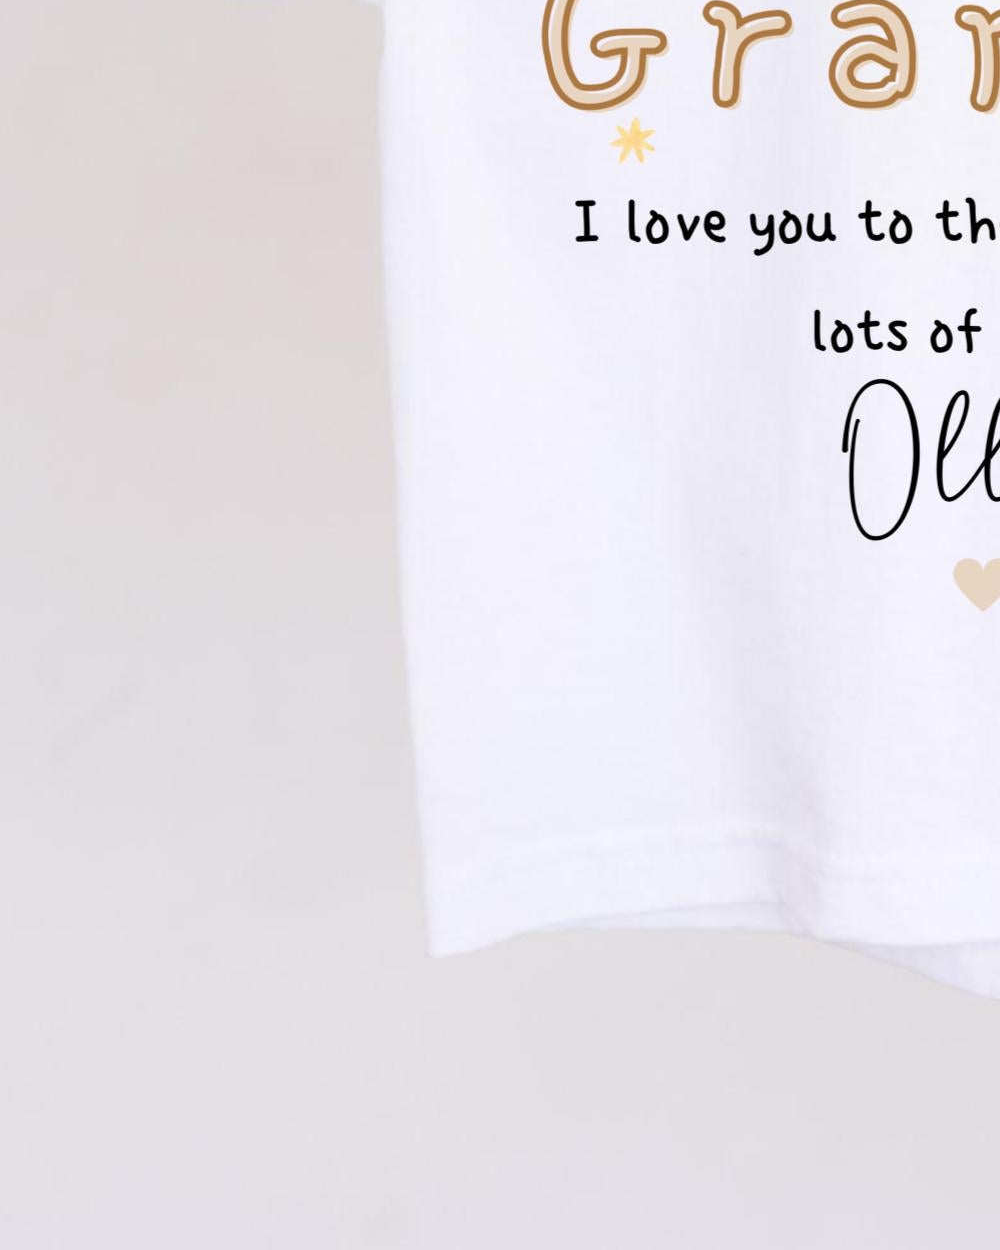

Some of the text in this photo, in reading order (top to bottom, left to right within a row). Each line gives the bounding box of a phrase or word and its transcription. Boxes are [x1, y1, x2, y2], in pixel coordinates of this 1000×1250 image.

[575, 200, 599, 242] I
[629, 200, 726, 244] love
[750, 212, 836, 256] you
[858, 200, 912, 244] to
[814, 310, 907, 353] lots
[930, 308, 981, 353] of
